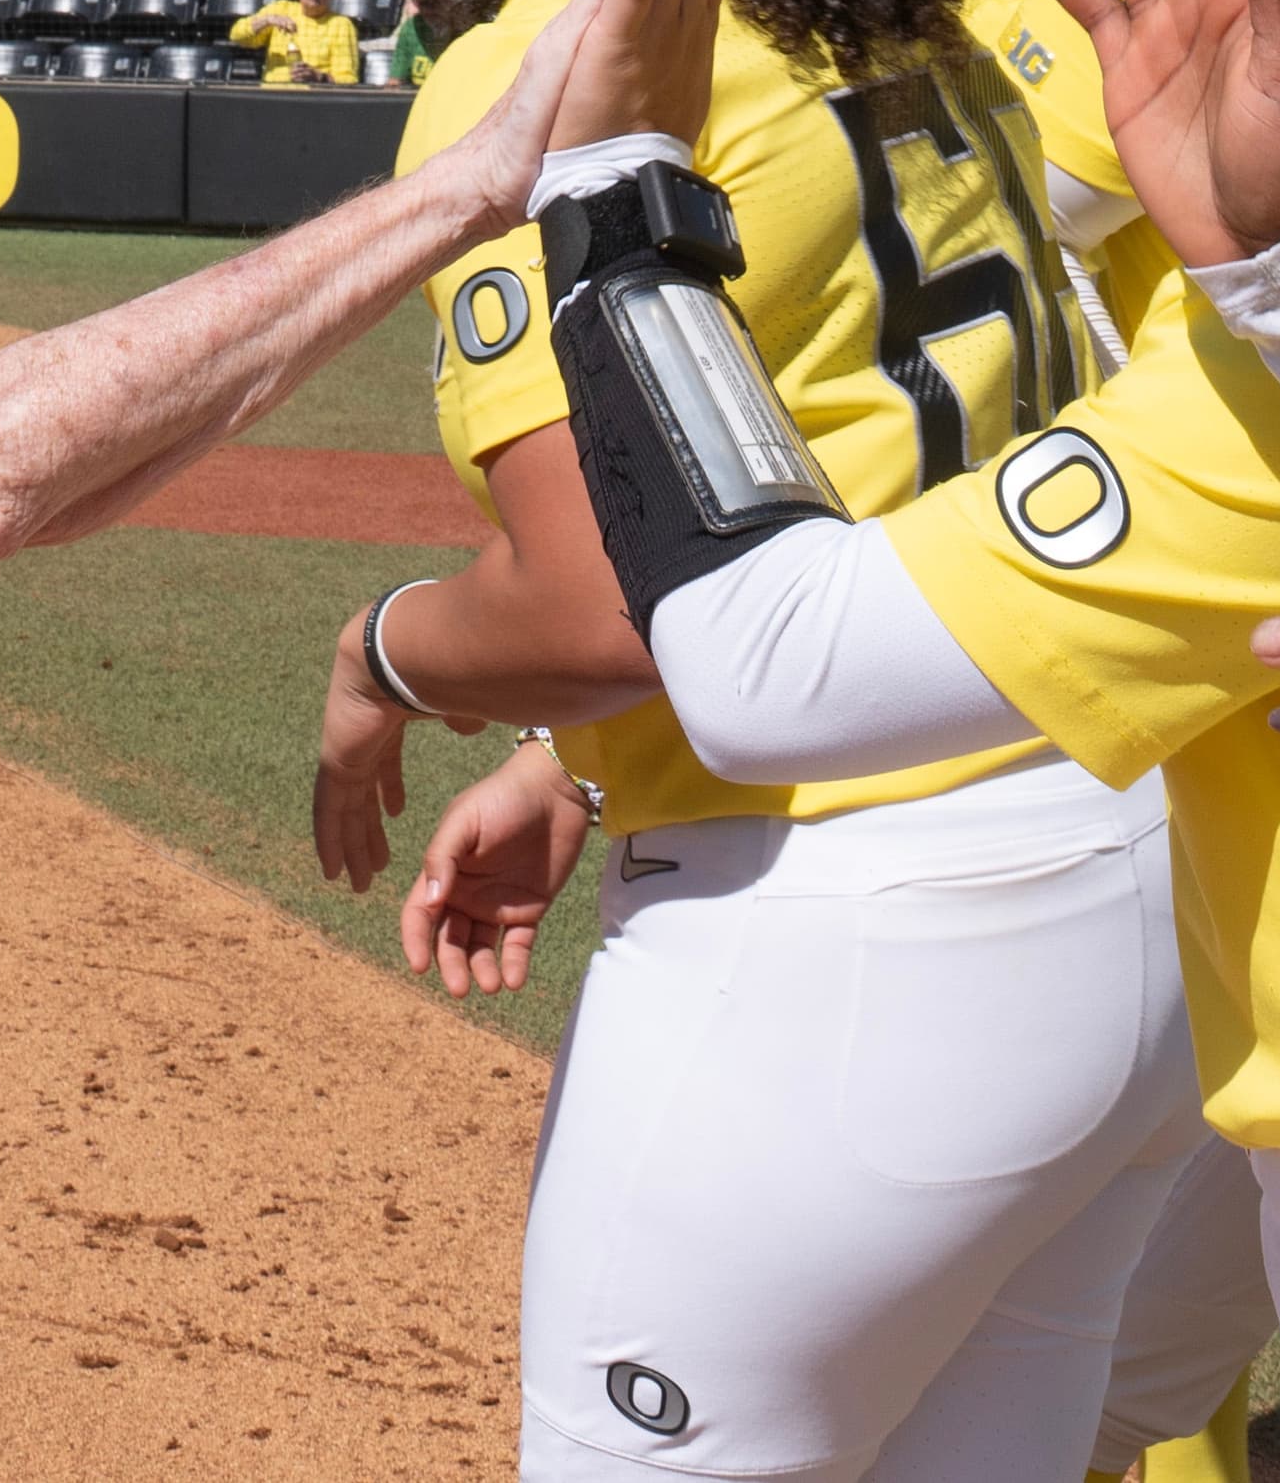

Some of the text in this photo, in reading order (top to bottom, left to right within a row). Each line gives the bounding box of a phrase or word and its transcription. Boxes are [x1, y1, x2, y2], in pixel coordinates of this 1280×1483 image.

[452, 266, 530, 365] O
[995, 425, 1132, 571] O
[606, 1360, 691, 1436] O
